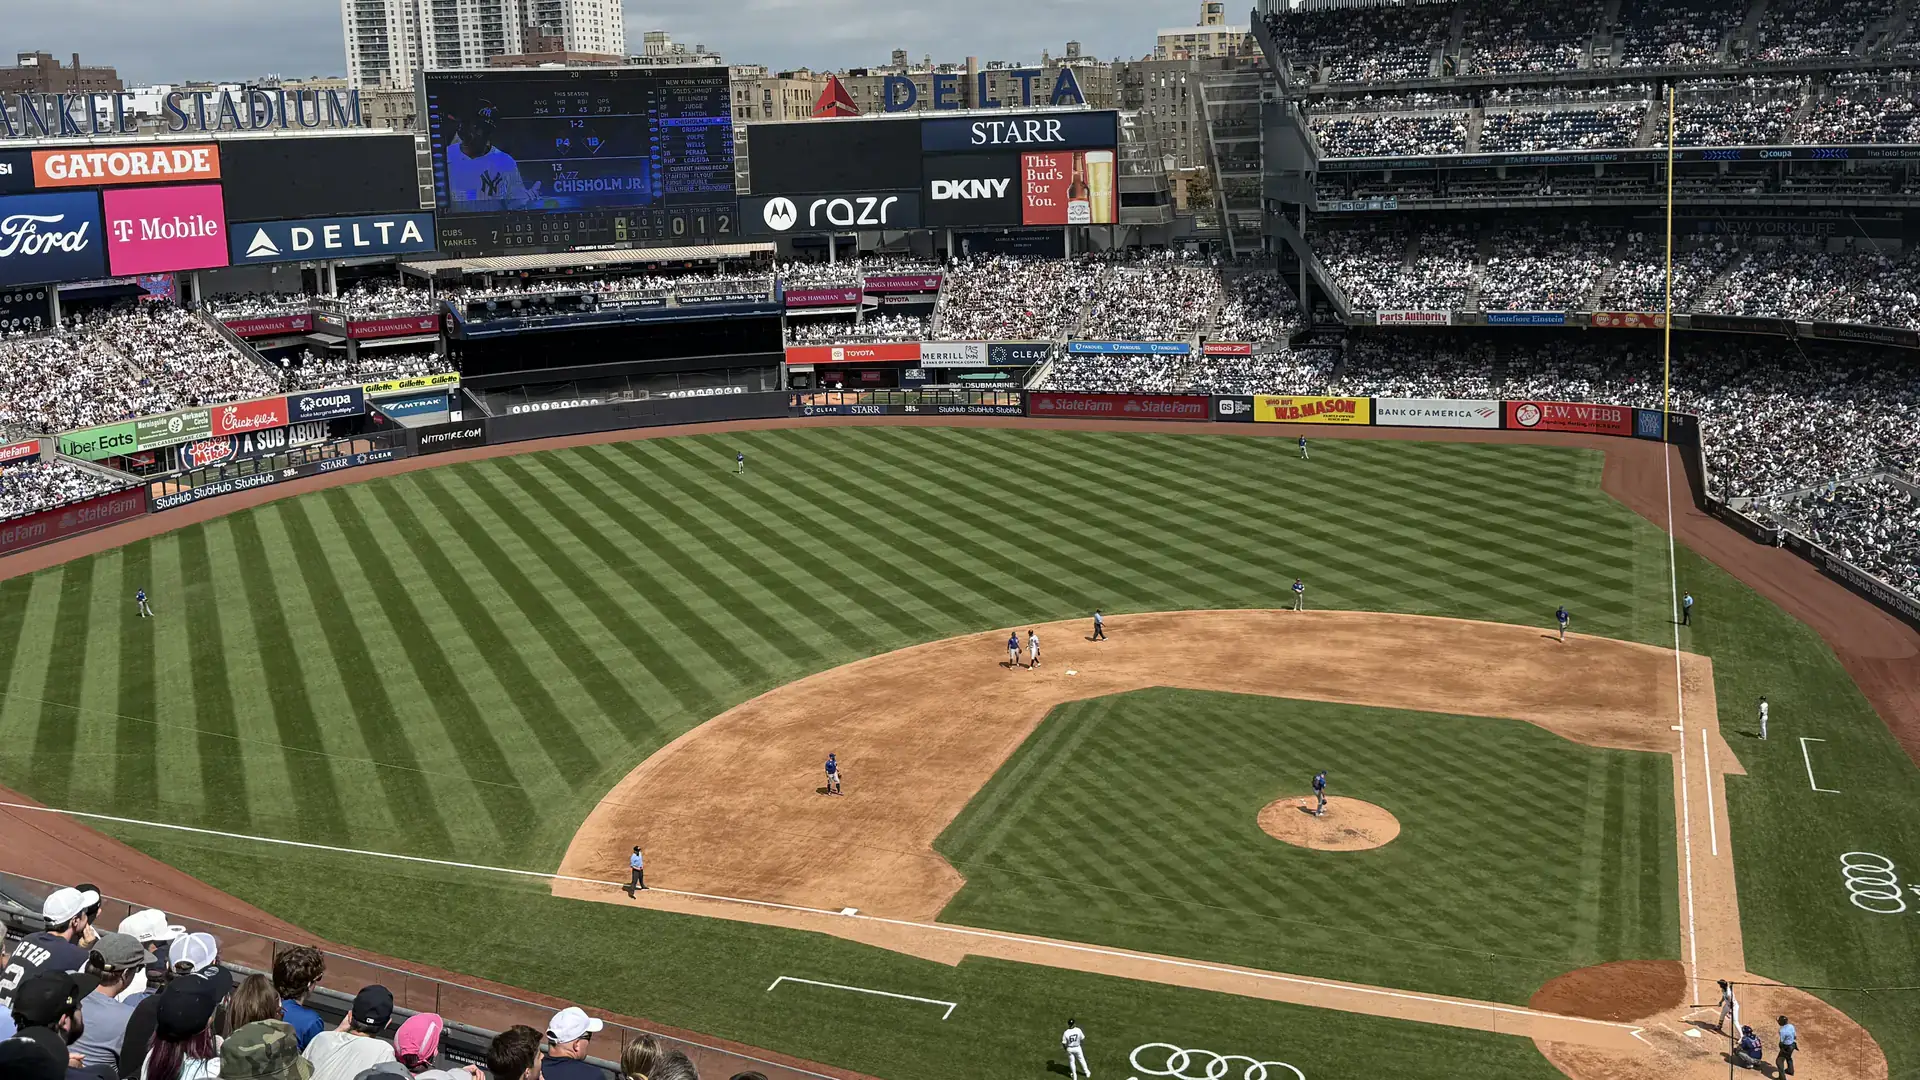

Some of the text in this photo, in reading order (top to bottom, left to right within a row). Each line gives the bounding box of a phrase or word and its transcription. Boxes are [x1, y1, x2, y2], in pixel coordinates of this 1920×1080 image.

[884, 67, 1087, 113] DELTA
[164, 89, 364, 132] STADIUM
[971, 119, 1065, 145] STARR
[45, 148, 211, 179] GATORADE
[1026, 156, 1056, 168] This
[553, 171, 578, 180] JAZZ
[1027, 168, 1063, 181] Bud's
[553, 178, 644, 192] CHISHOLM JR.
[931, 178, 1010, 200] DKNY
[1027, 182, 1050, 194] For
[1027, 195, 1056, 207] You.
[809, 197, 897, 226] razr
[140, 214, 218, 241] Mobile
[672, 215, 729, 235] 0 1 2
[1715, 222, 1836, 234] NEW YORK LIFE
[0, 214, 88, 256] Ford
[292, 220, 423, 252] DELTA
[491, 230, 498, 241] 7
[443, 239, 477, 247] YANKEES
[1380, 311, 1447, 323] Parts Authority
[1488, 315, 1563, 324] Montefiore Einstein
[248, 323, 285, 332] HAWAIIAN
[378, 324, 412, 332] HAWAIIAN
[365, 375, 458, 394] Gillette Gillette Gillette
[316, 394, 350, 408] coupa
[398, 399, 440, 409] AMTRAK
[222, 410, 278, 430] Chick-fil-A
[1379, 408, 1406, 417] BANK
[1424, 409, 1472, 418] AMERICA
[1543, 406, 1621, 422] F.W. WEBB
[138, 418, 166, 429] Morningside
[1640, 419, 1659, 428] YORK
[1642, 425, 1656, 433] LIFE
[244, 420, 331, 453] A SUB ABOVE
[421, 428, 481, 444] NITTOTIRE.COM
[64, 440, 96, 455] Uber
[99, 433, 134, 449] Eats
[190, 436, 229, 453] Jersey
[369, 451, 392, 460] CLEAR
[320, 459, 348, 471] STARR
[156, 491, 192, 510] StubHub
[194, 482, 231, 500] StubHub
[234, 473, 274, 490] StubHub
[1826, 557, 1848, 579] StubHub
[1849, 570, 1871, 592] StubHub
[1871, 584, 1896, 606] StubHub
[1068, 1034, 1078, 1043] 67
